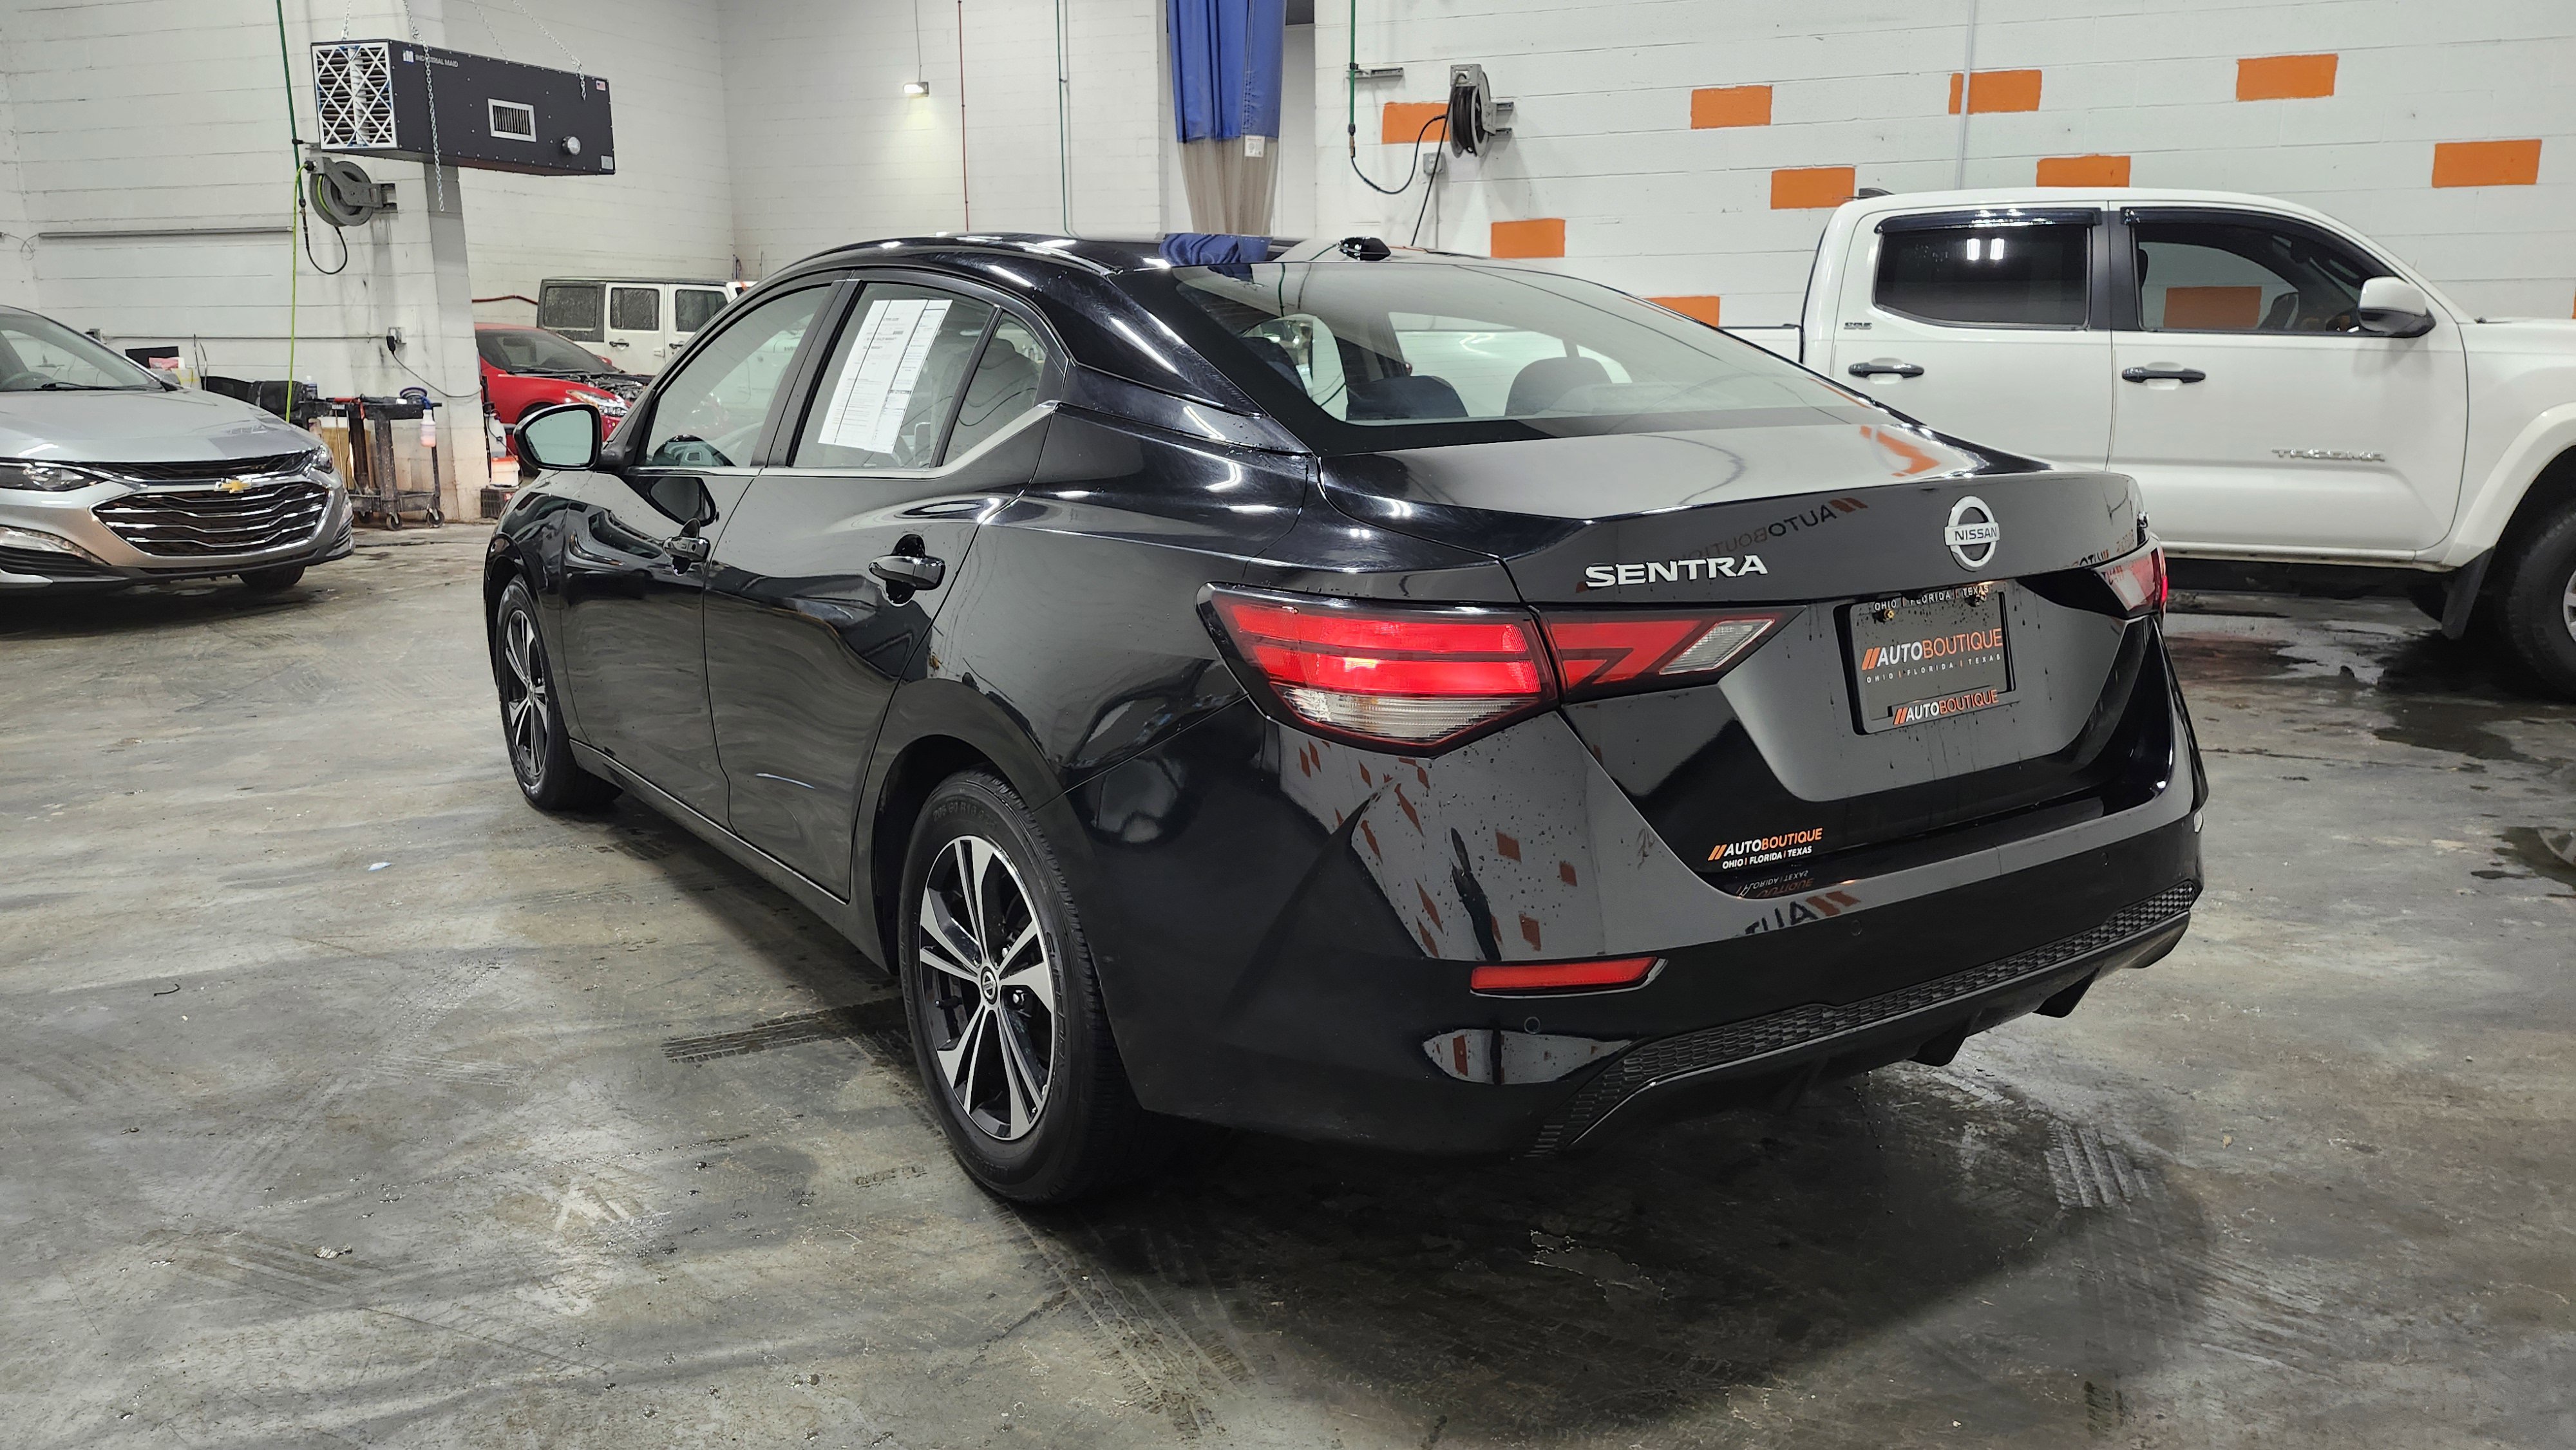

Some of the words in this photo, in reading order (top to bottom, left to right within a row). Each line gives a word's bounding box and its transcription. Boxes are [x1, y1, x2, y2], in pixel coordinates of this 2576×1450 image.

[1955, 527, 1997, 541] NISSAN
[1585, 554, 1769, 588] SENTRA
[1874, 599, 1897, 610] OHIO
[1963, 585, 1989, 597] TEXAS
[1877, 628, 2003, 667] AUTOBOUTIQUE
[1866, 673, 1893, 684] OHIO
[1907, 662, 1954, 676] FLORIDA
[1967, 653, 2001, 666] TEXAS
[1905, 689, 2000, 722] AUTOBOUTIQUE
[1722, 858, 1744, 869] OHIO
[1749, 852, 1783, 865] FLORIDA
[1787, 845, 1812, 858] TEXAS
[1723, 827, 1823, 857] AUTOBOUTIQUE
